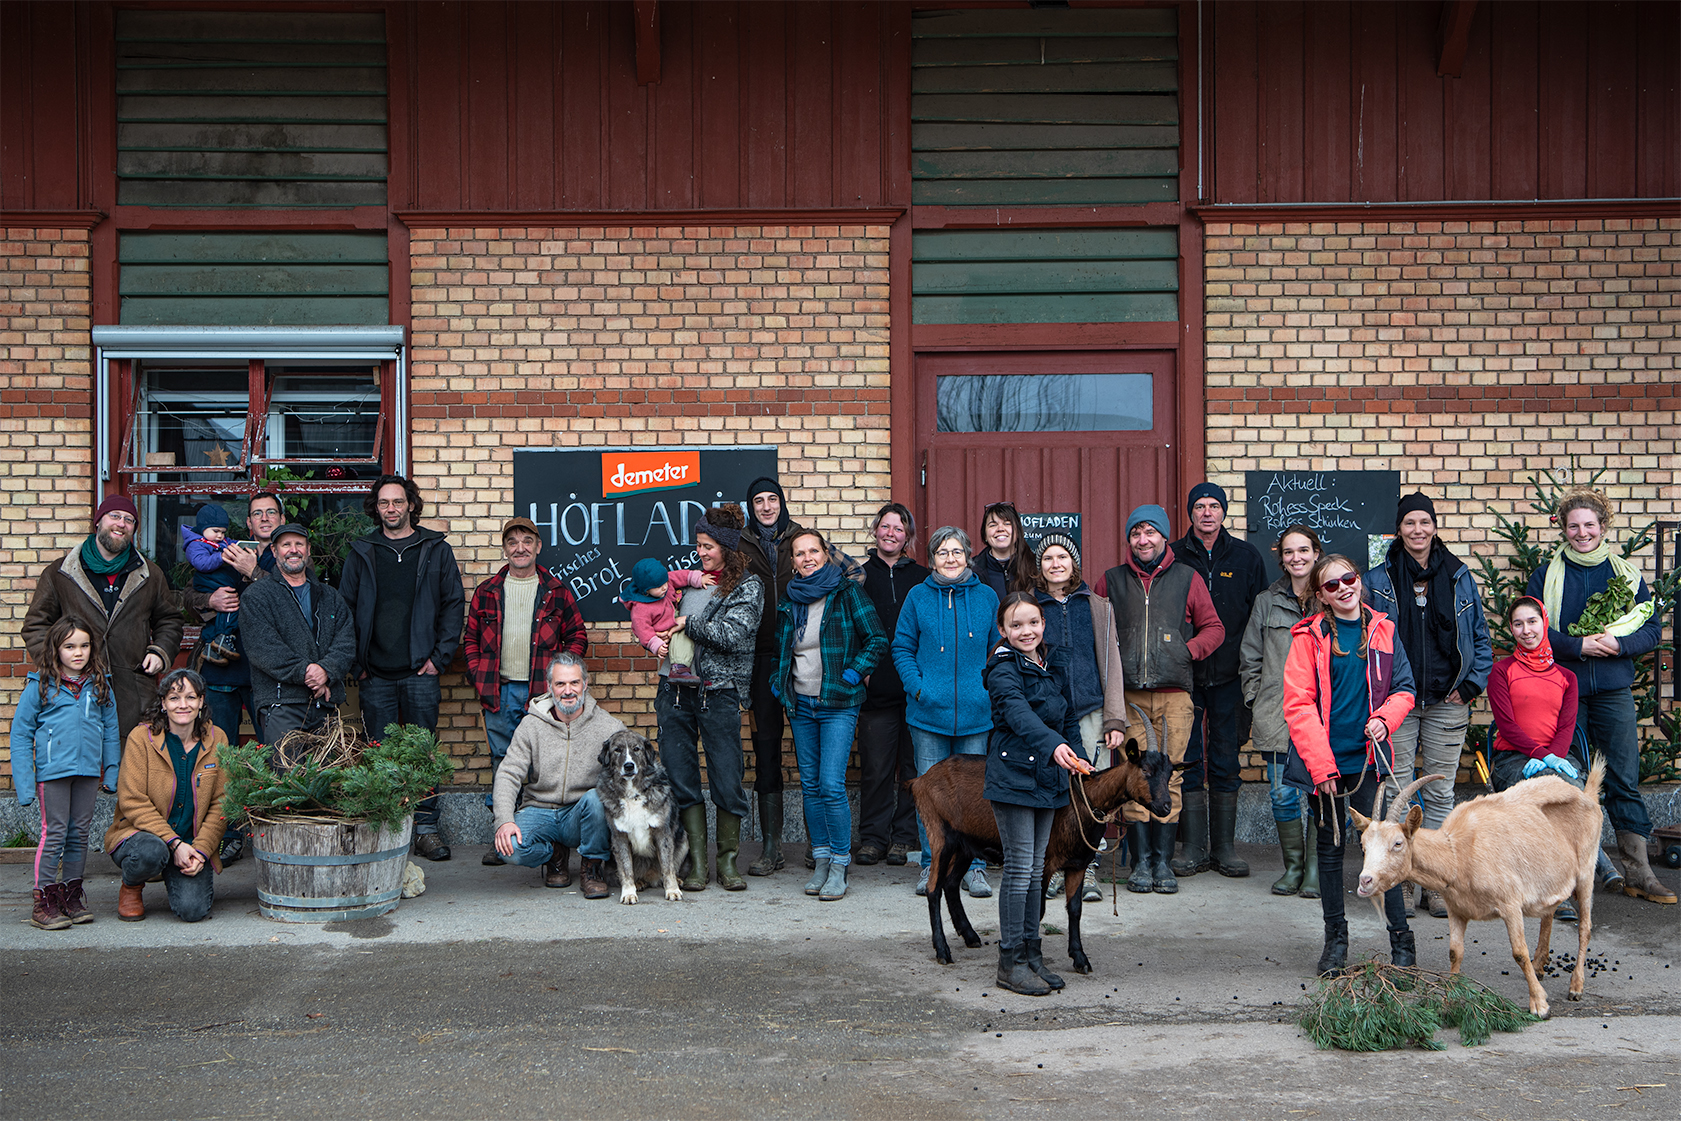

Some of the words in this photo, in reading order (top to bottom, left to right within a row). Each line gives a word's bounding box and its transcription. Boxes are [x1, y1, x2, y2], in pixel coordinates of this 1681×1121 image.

[610, 462, 689, 488] demeter
[529, 500, 750, 547] HOFLAD
[1308, 493, 1354, 521] Speck
[549, 547, 602, 580] frisches
[570, 557, 624, 602] Brot
